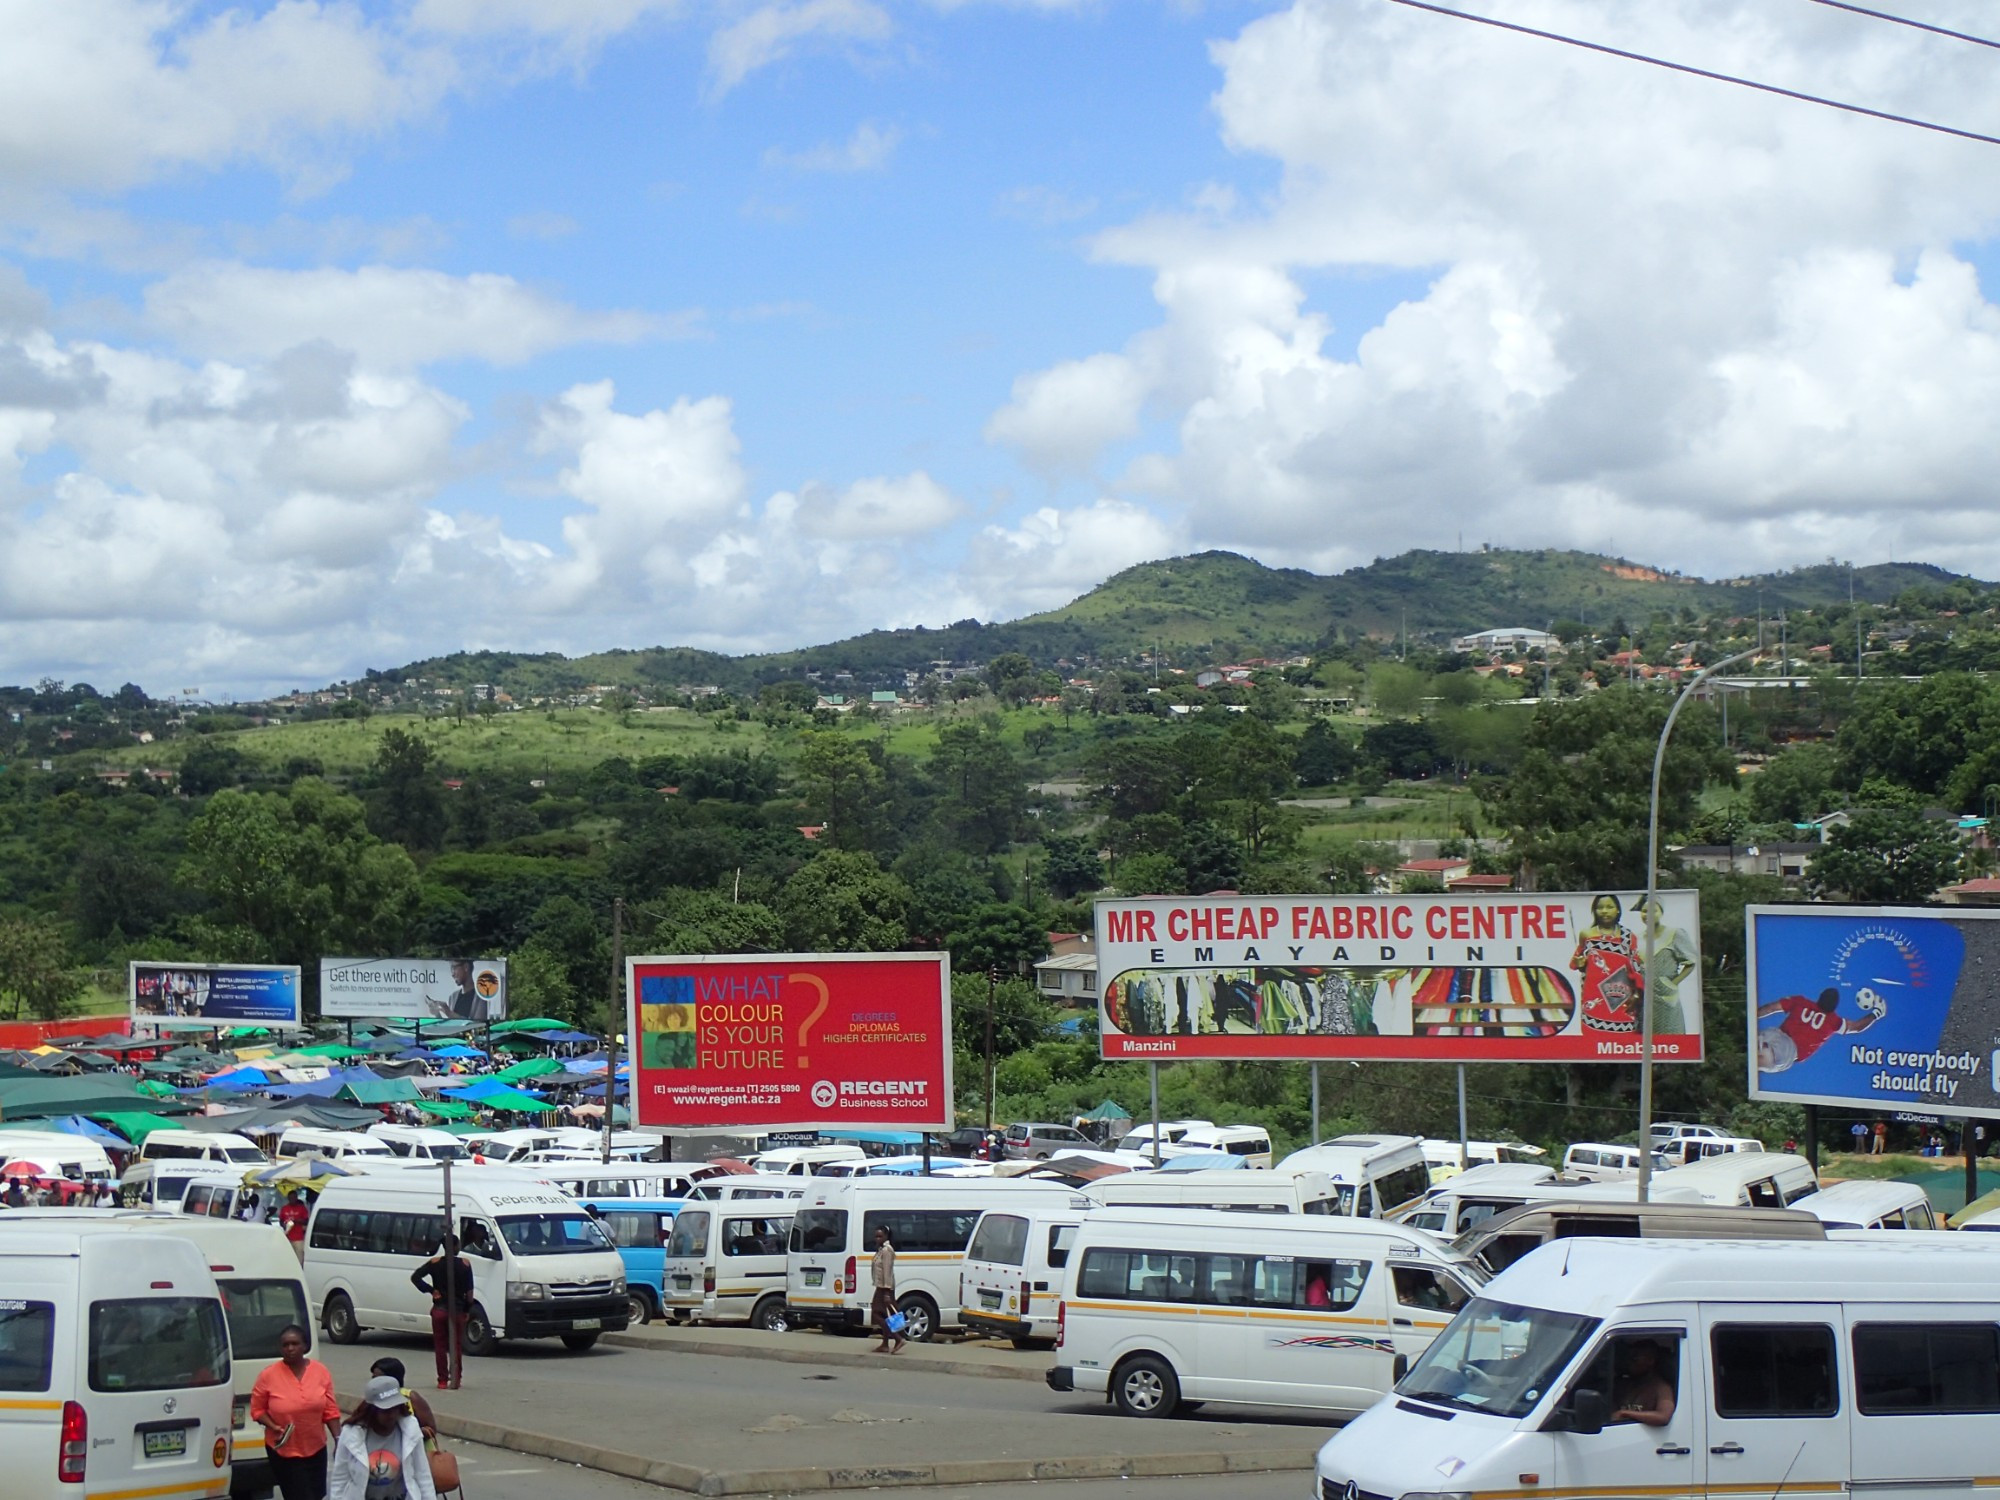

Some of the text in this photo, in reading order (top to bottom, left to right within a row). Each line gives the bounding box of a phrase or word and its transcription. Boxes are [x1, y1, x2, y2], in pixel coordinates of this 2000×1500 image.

[1107, 904, 1566, 943] MR CHEAP FABRIC CENTRE
[329, 968, 439, 984] Get there with Gold.
[330, 983, 350, 992] Switch
[351, 984, 357, 992] to
[358, 985, 373, 993] more
[699, 975, 784, 1000] WHAT
[700, 1004, 783, 1023] COLOUR
[851, 1012, 897, 1022] DEGREES
[849, 1022, 900, 1032] DIPLOMAS
[701, 1025, 784, 1045] IS YOUR
[823, 1033, 927, 1043] HIGHER CERTIFICATES
[1123, 1040, 1176, 1052] Manzini
[1597, 1041, 1680, 1055] Mbabane
[701, 1050, 784, 1070] FUTURE
[1851, 1046, 1980, 1075] Not everybody
[654, 1084, 800, 1094] [E] swazi@regent.ac.za [T] 2505 5890
[840, 1081, 928, 1095] REGENT
[1872, 1070, 1959, 1098] should fly
[673, 1094, 781, 1106] www.regent.ac.za
[840, 1098, 928, 1108] Business School
[1896, 1112, 1938, 1124] JCDecaux
[772, 1132, 813, 1141] JCDecaux
